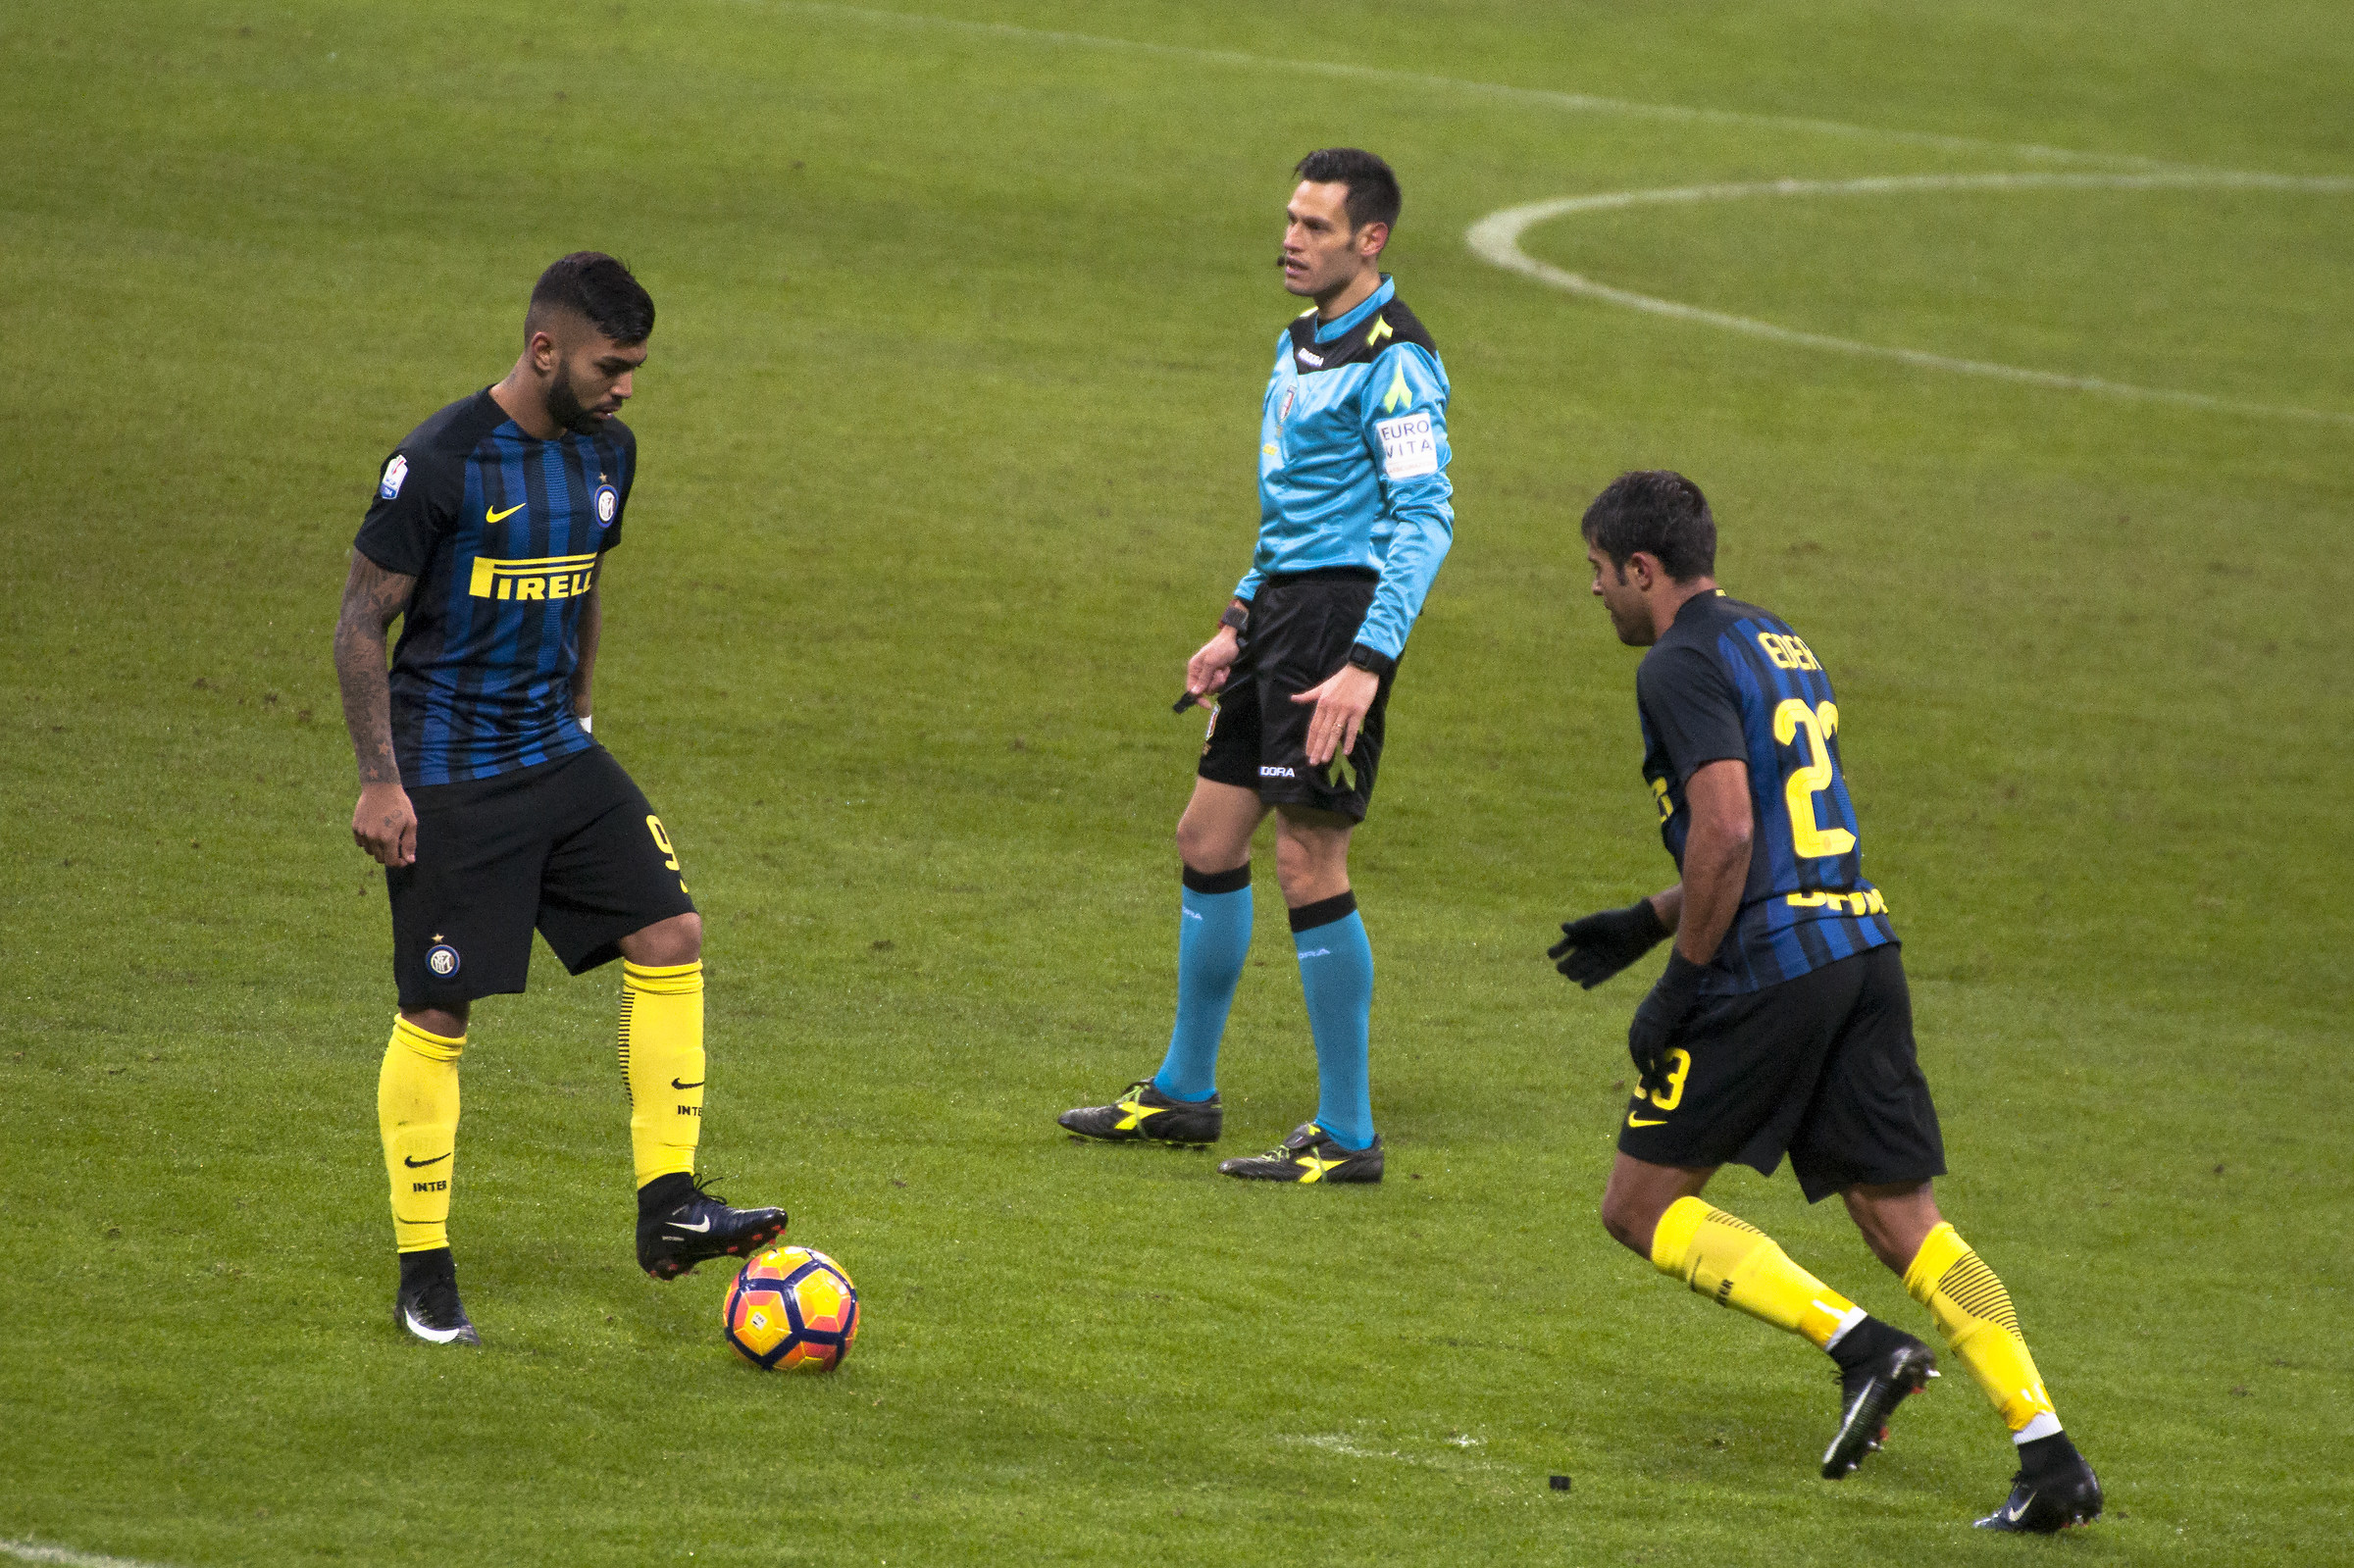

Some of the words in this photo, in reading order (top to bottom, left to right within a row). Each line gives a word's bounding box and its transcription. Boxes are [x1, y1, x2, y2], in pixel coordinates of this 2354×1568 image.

[1381, 420, 1430, 441] EURO
[1385, 438, 1433, 459] VITA
[469, 551, 598, 600] PIRELL
[1259, 766, 1296, 778] DORA
[645, 814, 681, 871] 9
[677, 1104, 703, 1117] INTE
